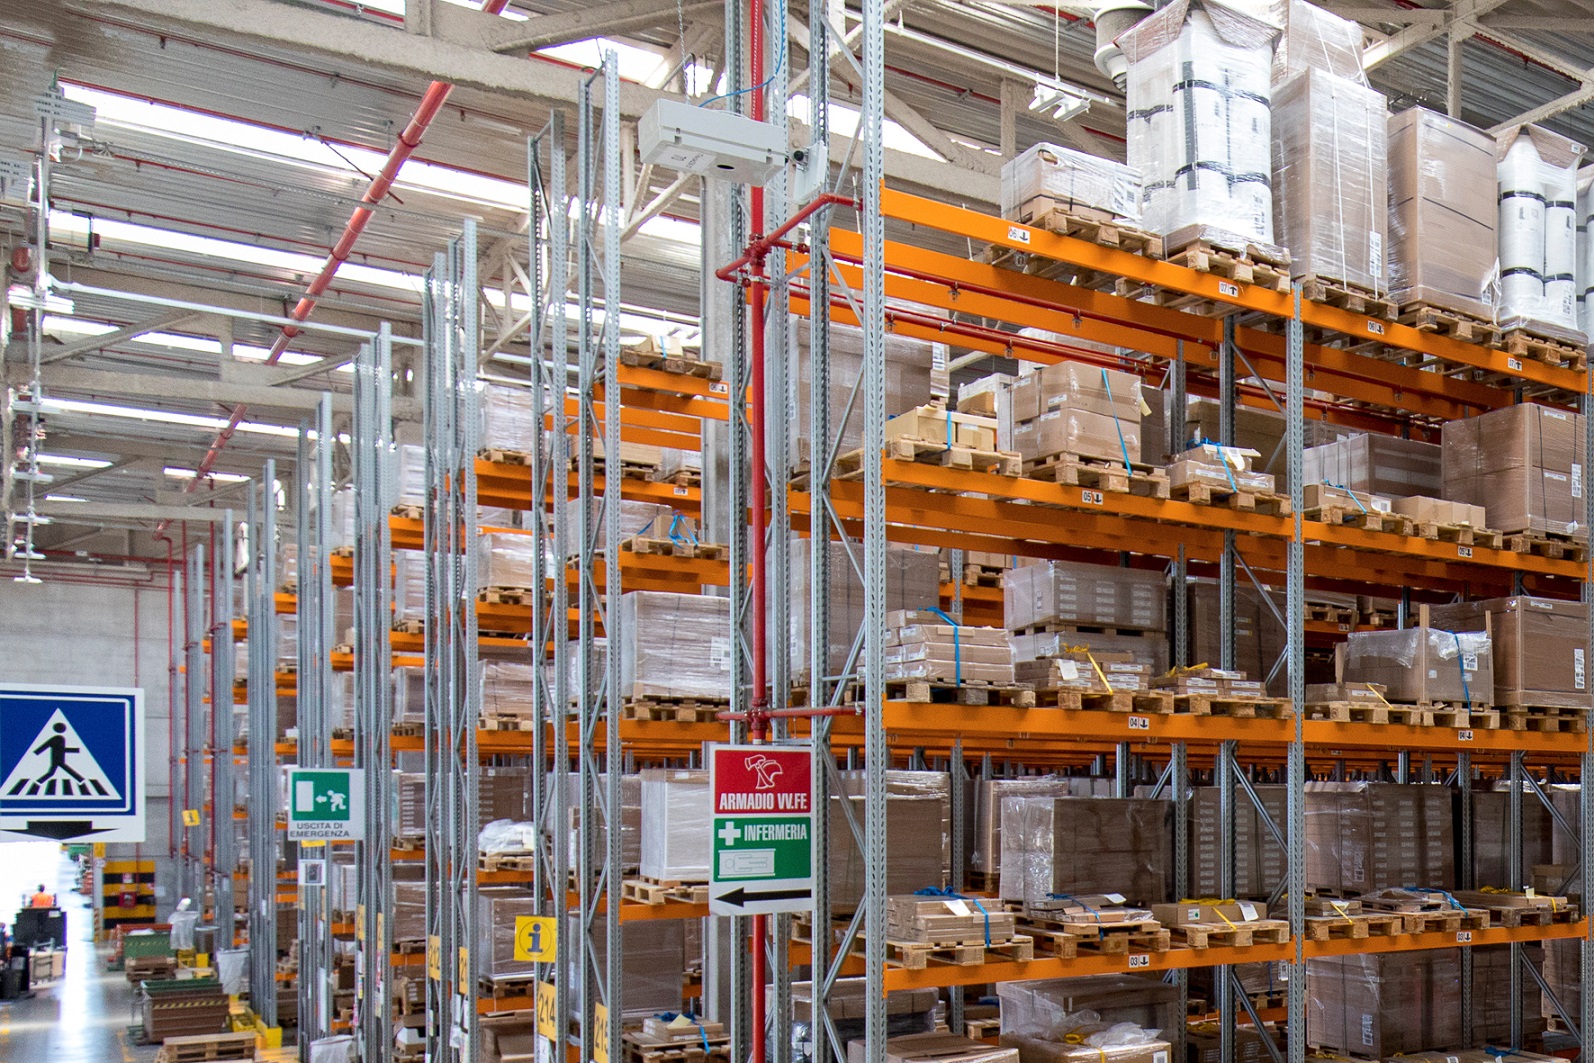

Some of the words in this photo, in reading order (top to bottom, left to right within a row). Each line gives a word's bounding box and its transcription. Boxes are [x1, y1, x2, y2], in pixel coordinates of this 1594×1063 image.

[1084, 491, 1092, 502] 05
[1130, 717, 1137, 727] 04
[719, 793, 775, 810] ARMADIO
[777, 793, 807, 809] VV.FF.
[297, 822, 331, 830] USCITA
[290, 830, 350, 838] EMERGENZA
[744, 824, 808, 841] INFERMERIA
[1130, 956, 1138, 966] 03
[539, 992, 555, 1028] 214
